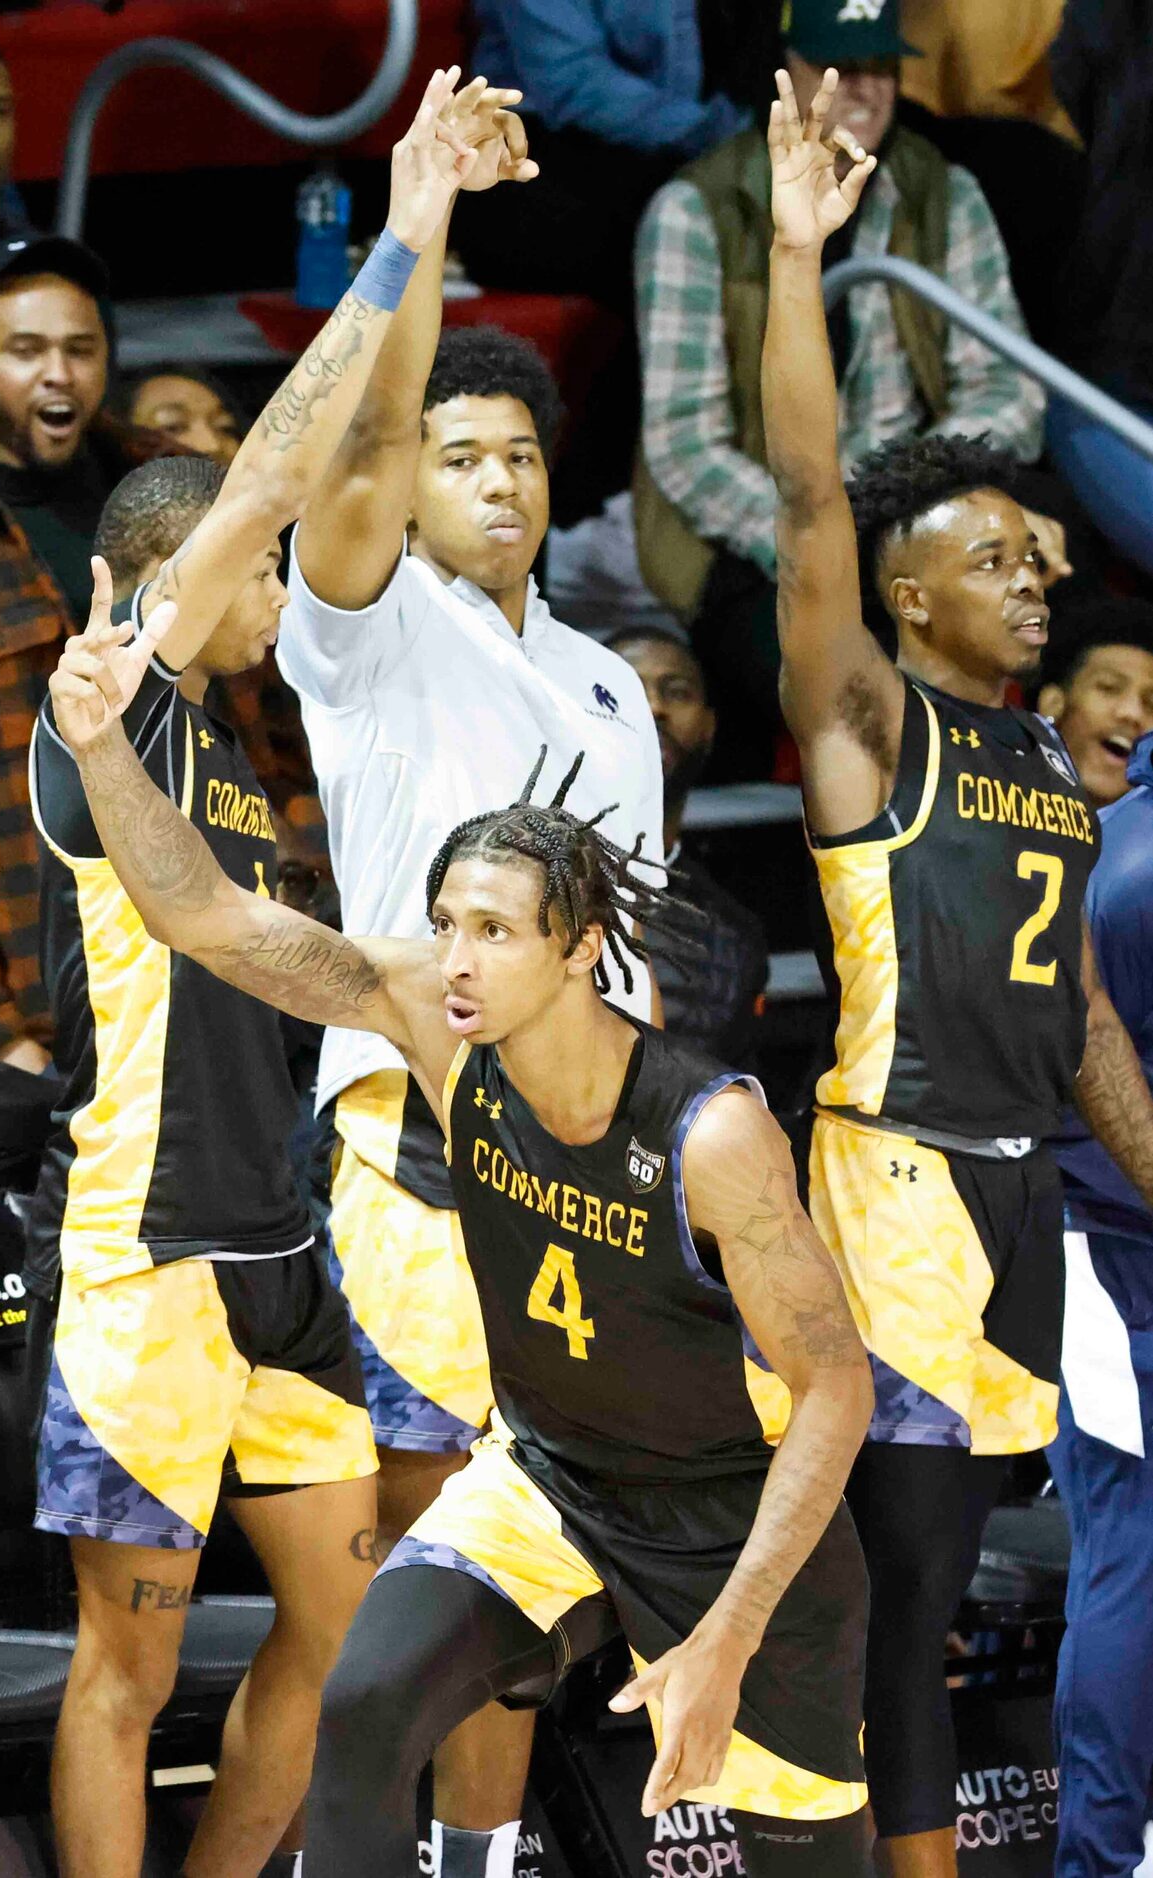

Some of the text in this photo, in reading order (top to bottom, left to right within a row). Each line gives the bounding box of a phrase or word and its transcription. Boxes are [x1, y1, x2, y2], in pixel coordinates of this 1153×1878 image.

[957, 772, 1094, 846] COMMERCE
[1009, 850, 1064, 987] 2
[242, 922, 382, 1009] Humble
[472, 1137, 649, 1258] COMMERCE
[628, 1155, 654, 1185] 60
[526, 1241, 596, 1361] 4
[955, 1804, 1041, 1850] COPE
